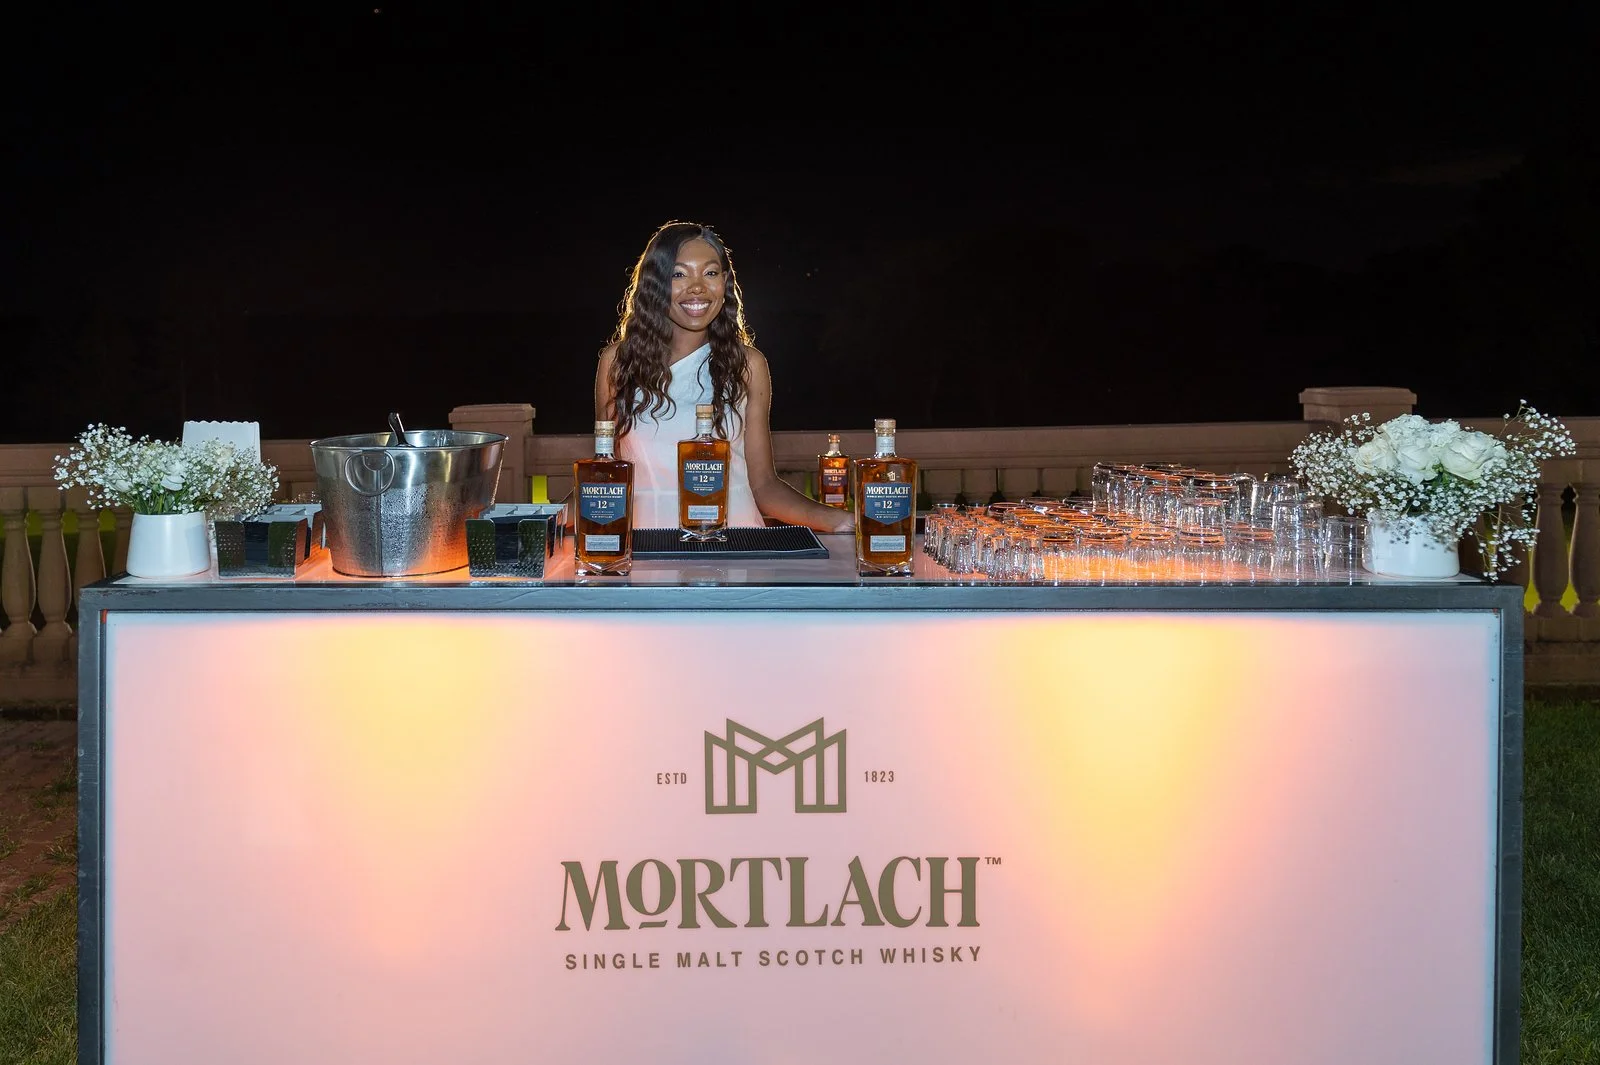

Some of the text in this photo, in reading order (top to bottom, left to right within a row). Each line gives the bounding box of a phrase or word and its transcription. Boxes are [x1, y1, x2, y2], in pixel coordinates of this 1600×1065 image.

[685, 462, 723, 471] MORTLACH
[699, 474, 709, 483] 12
[581, 486, 624, 495] MORTLACH
[866, 486, 909, 495] MORTLACH
[597, 500, 608, 509] 12
[882, 500, 893, 509] 12
[656, 772, 687, 785] ESTD
[864, 770, 895, 783] 1823
[554, 855, 980, 932] MORTLACH
[565, 945, 981, 970] SINGLE MALT SCOTCH WHISKY
